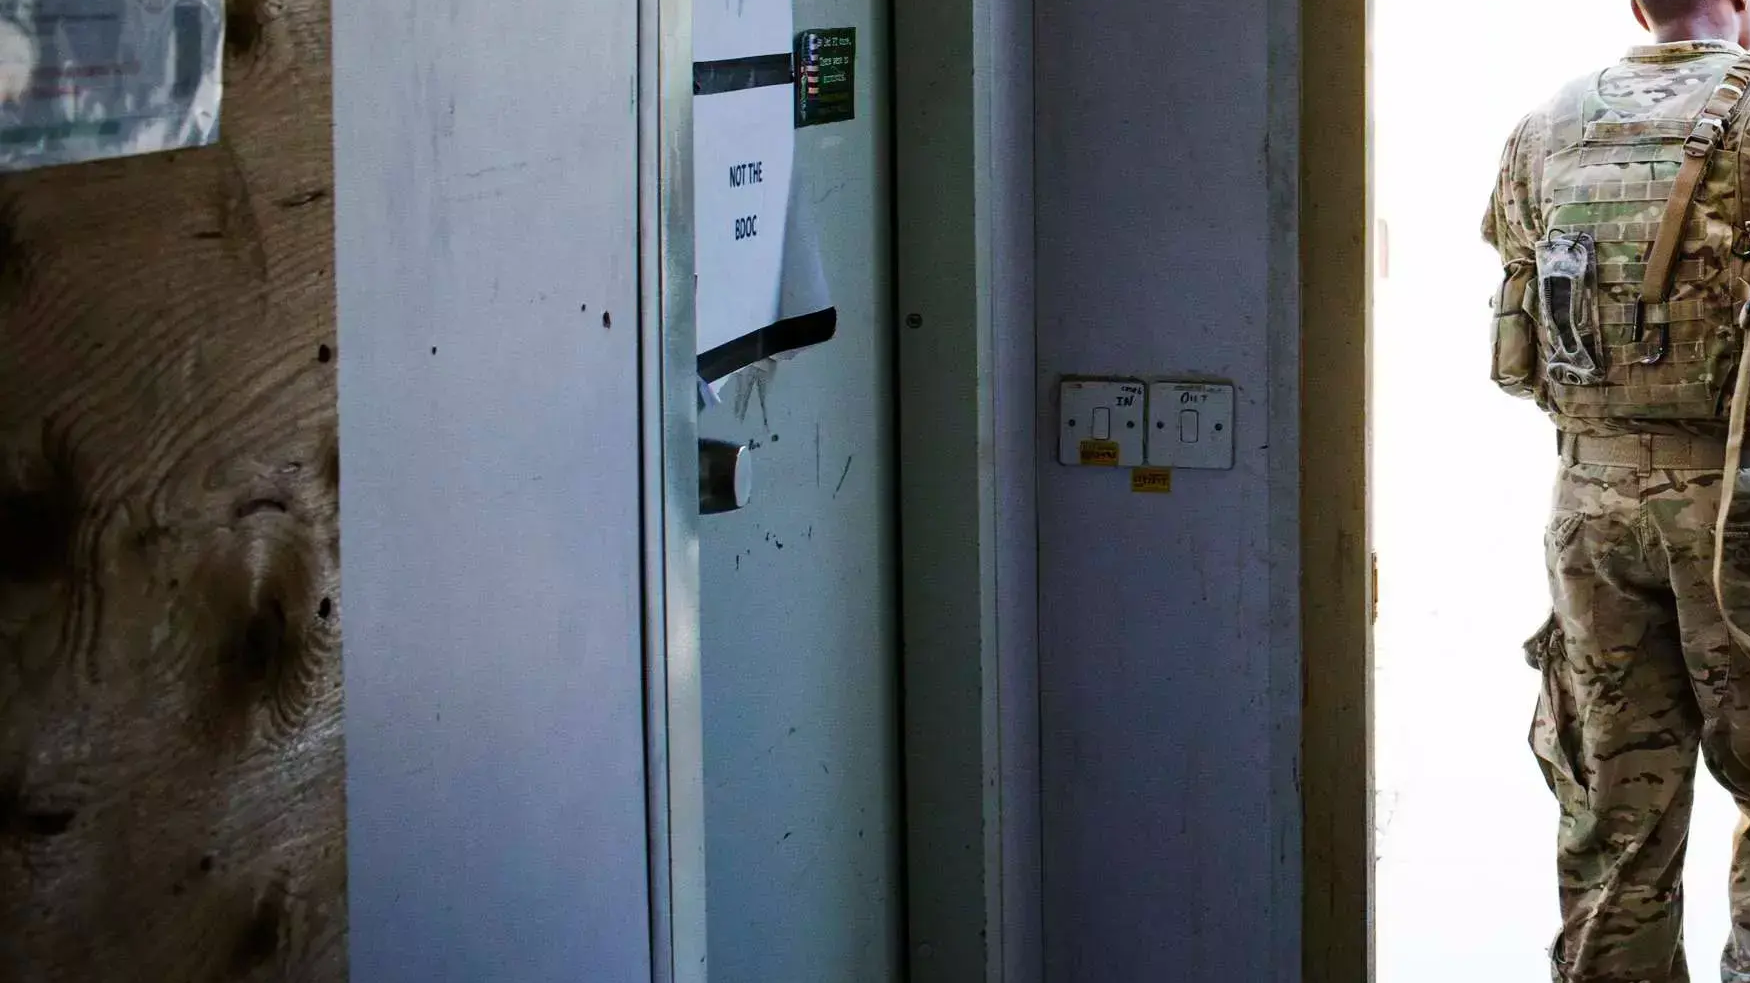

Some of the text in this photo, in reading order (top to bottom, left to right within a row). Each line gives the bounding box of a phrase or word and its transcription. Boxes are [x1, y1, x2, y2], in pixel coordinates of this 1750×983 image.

[729, 161, 763, 188] NOT THE
[735, 214, 757, 240] BDOC
